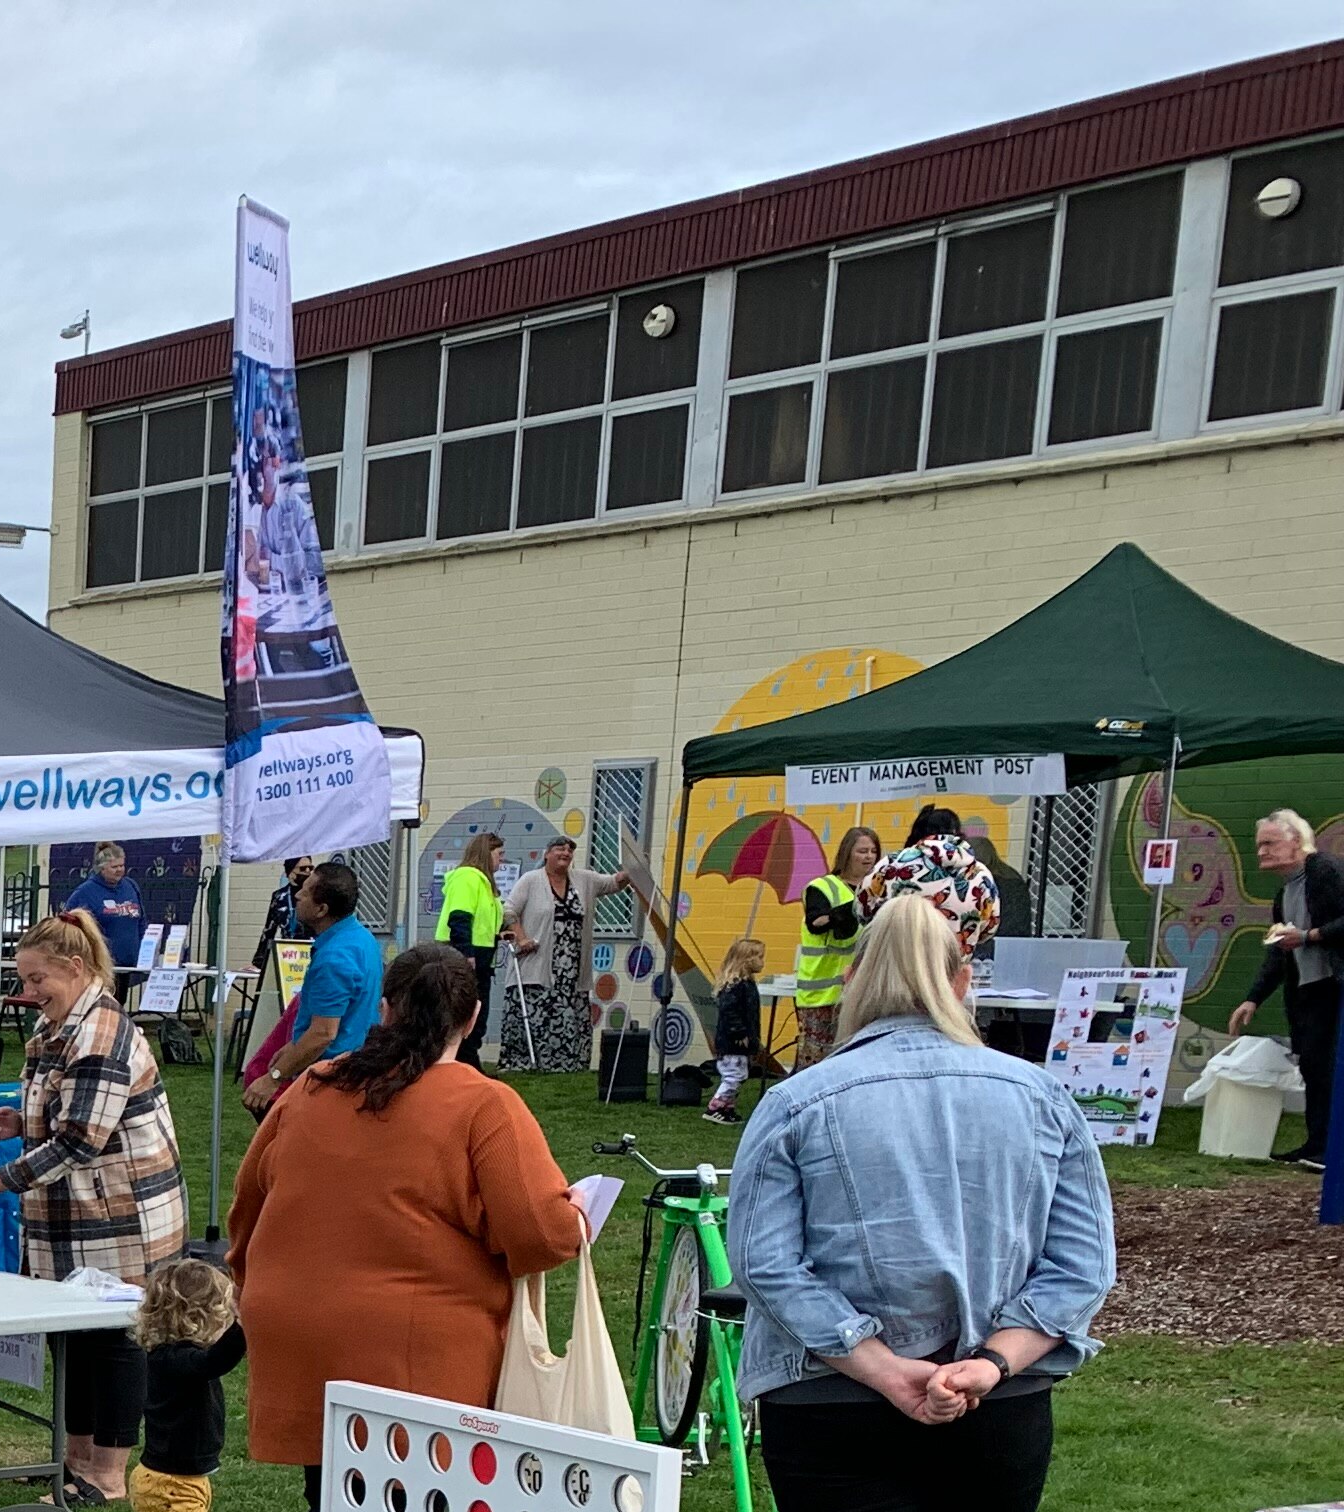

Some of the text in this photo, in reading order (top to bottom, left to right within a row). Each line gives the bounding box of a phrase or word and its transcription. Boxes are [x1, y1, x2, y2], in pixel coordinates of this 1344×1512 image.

[255, 768, 354, 803] 1300 111 400
[811, 757, 1035, 786] EVENT MANAGEMENT POST
[458, 1413, 500, 1434] GoSports
